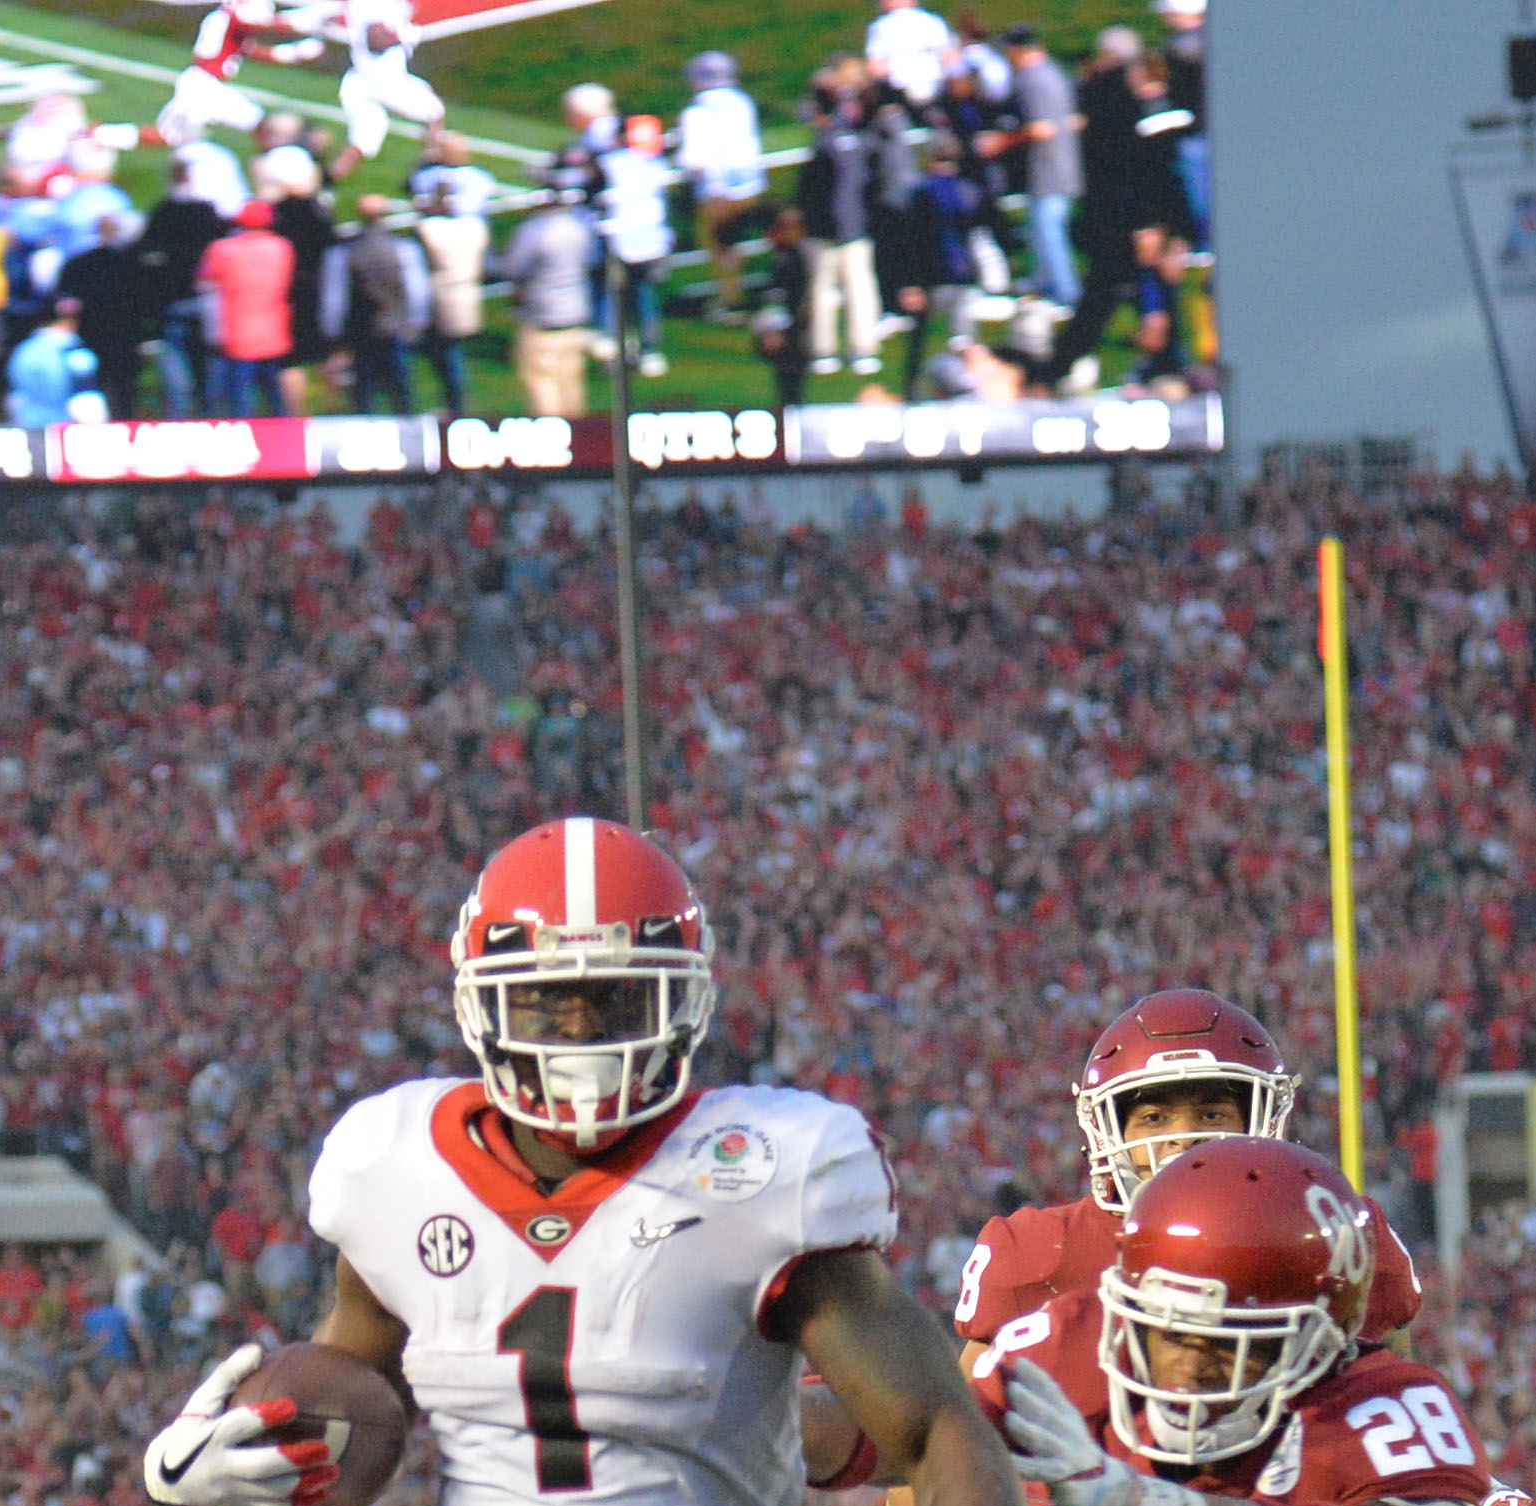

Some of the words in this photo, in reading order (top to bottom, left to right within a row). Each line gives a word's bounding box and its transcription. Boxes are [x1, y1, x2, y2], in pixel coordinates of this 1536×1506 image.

[420, 1217, 472, 1276] SEC
[529, 1218, 571, 1242] G
[498, 1285, 593, 1493] 1
[1345, 1384, 1476, 1477] 28
